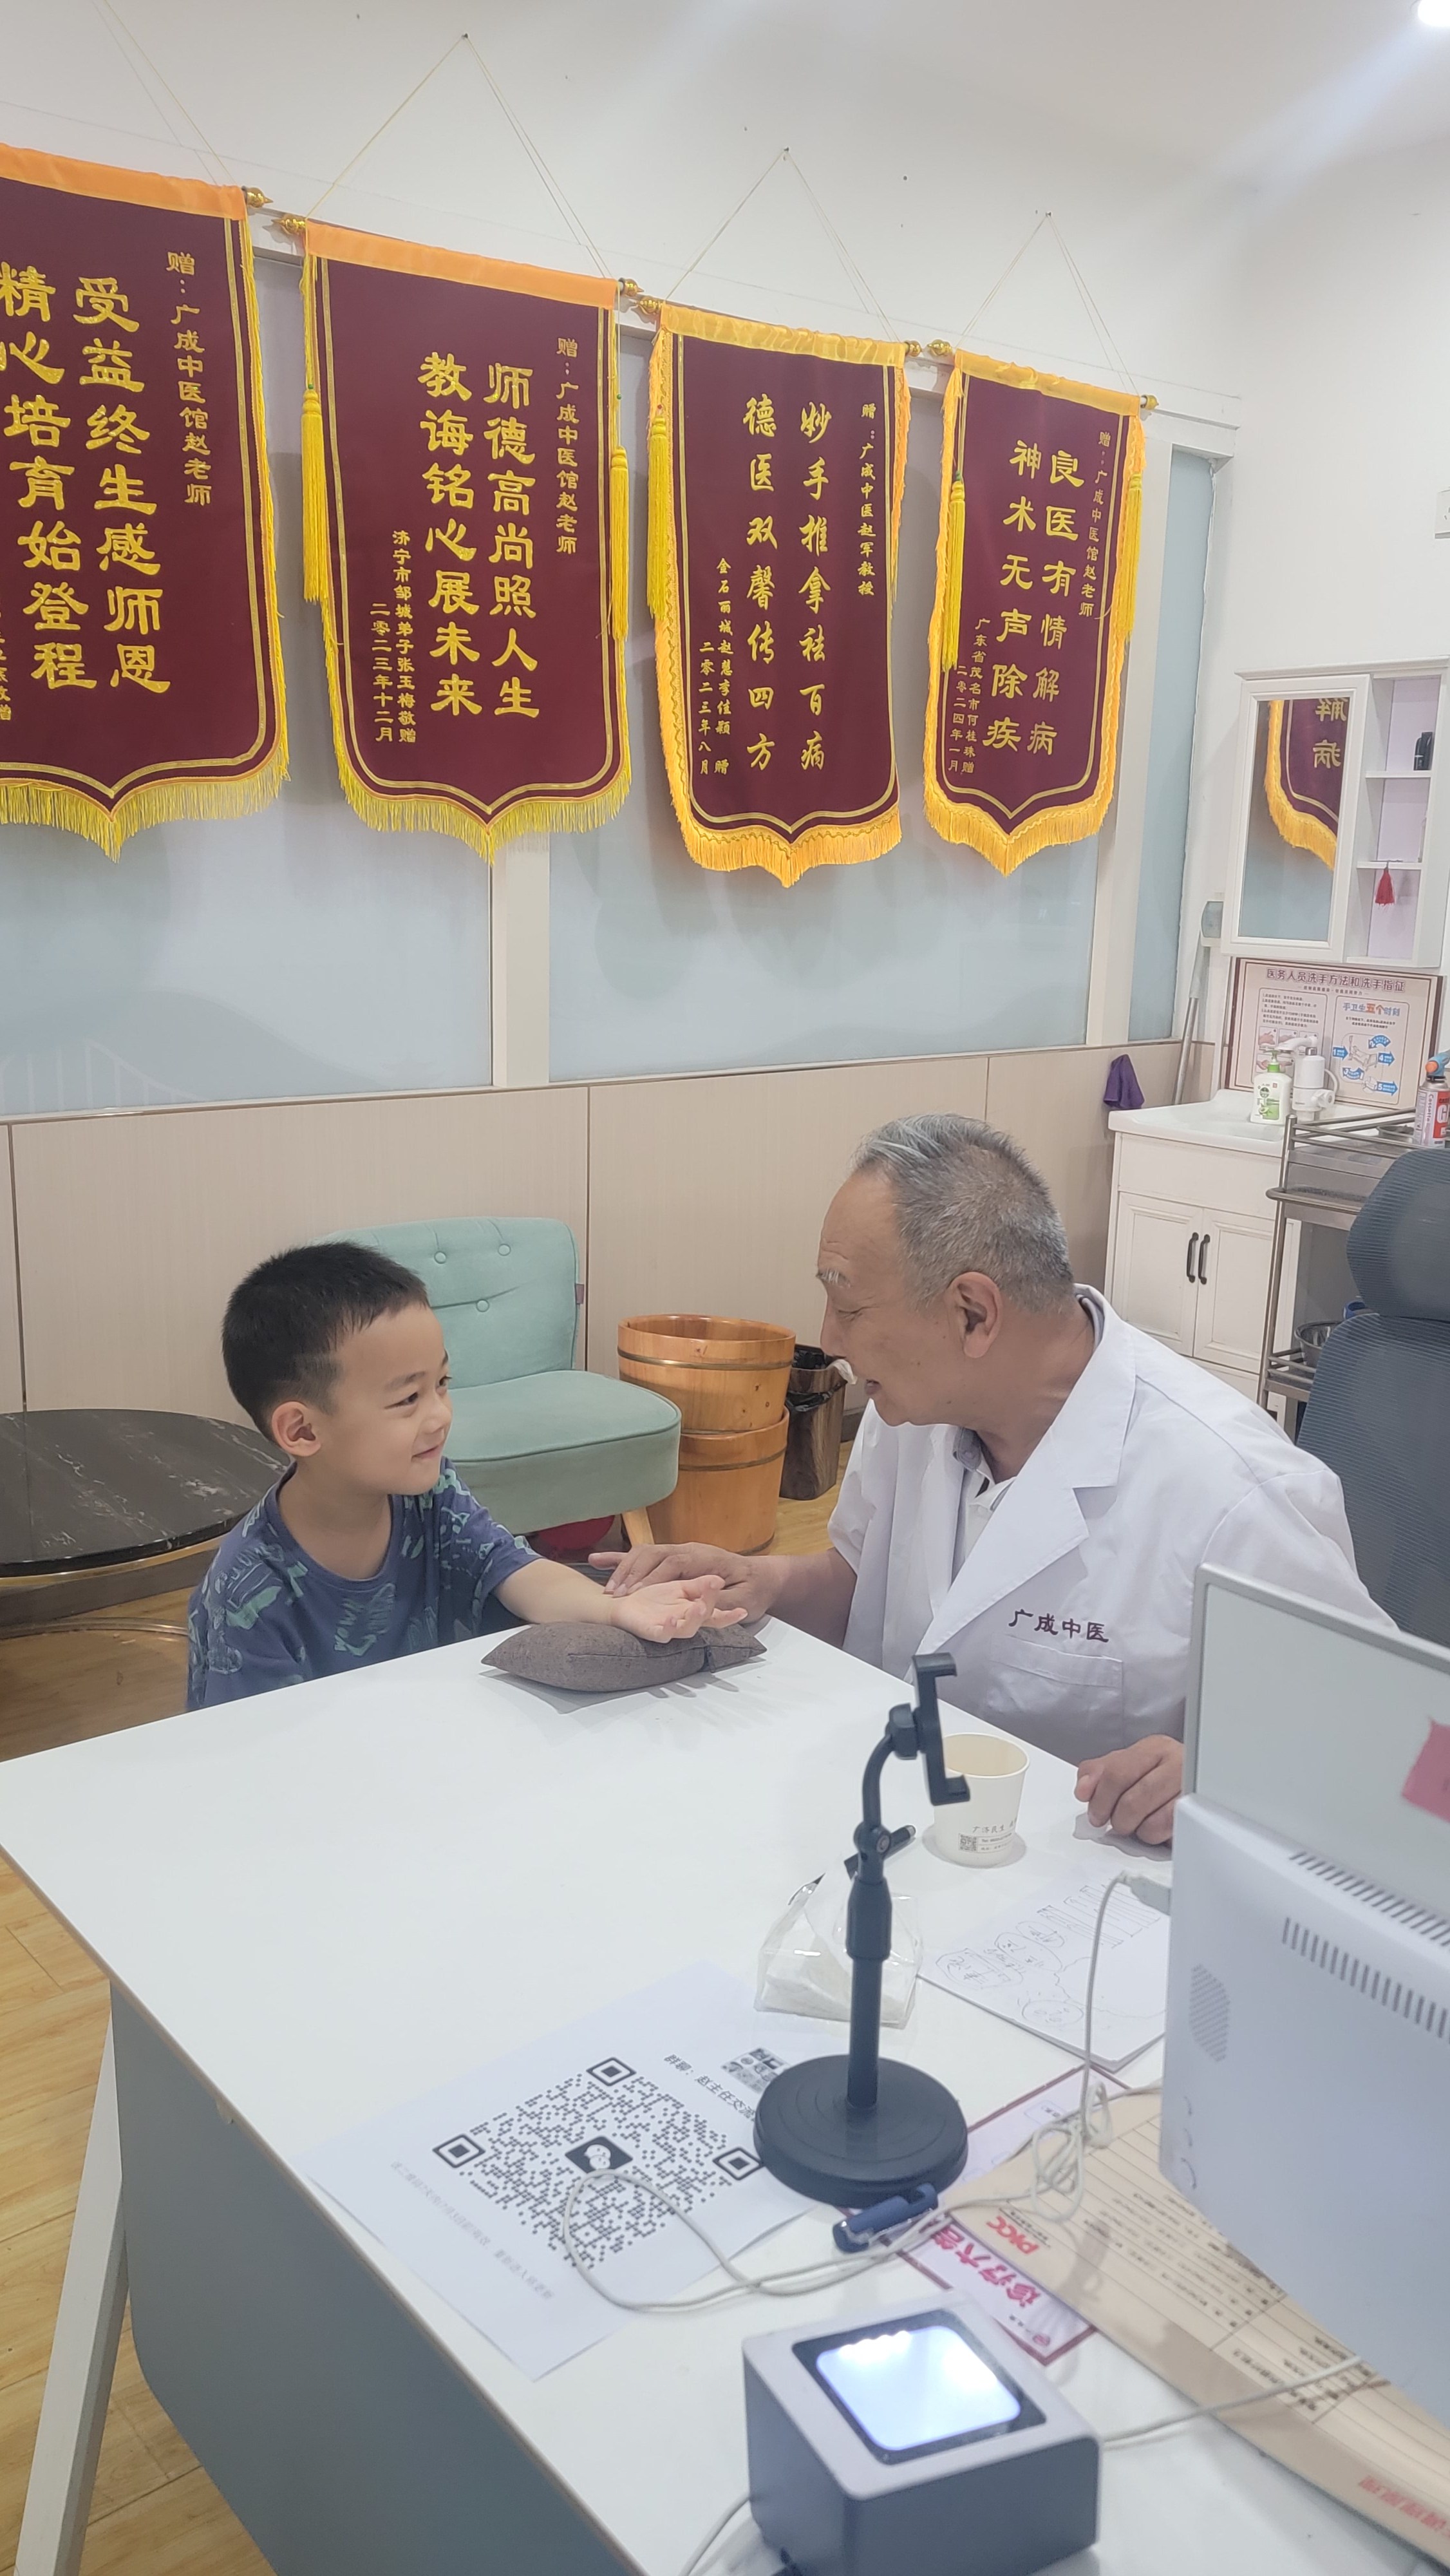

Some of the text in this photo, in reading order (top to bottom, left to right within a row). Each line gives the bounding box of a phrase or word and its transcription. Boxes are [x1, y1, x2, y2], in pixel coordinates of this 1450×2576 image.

[0, 261, 97, 689] 精心培育始登程
[73, 276, 171, 693] 受益终生感师恩
[417, 352, 482, 717] 教诲铭心展未来
[483, 362, 540, 717] 师德高尚照人生
[742, 393, 778, 772] 德医双馨传四方
[798, 401, 832, 772] 妙手推拿祛百病
[983, 440, 1041, 752] 神术无声除疾
[1026, 450, 1085, 756] 良医有情解病
[370, 602, 393, 742] 二零二三年十二月
[698, 641, 715, 775] 二零二三年八月
[948, 665, 968, 772] 二零二四年一月
[1266, 968, 1406, 992] 医务人员洗手方法和洗手指征
[1008, 1609, 1109, 1642] 广成中医
[664, 2054, 756, 2123] 群聊：赵主任交流
[986, 2215, 1039, 2254] PICC
